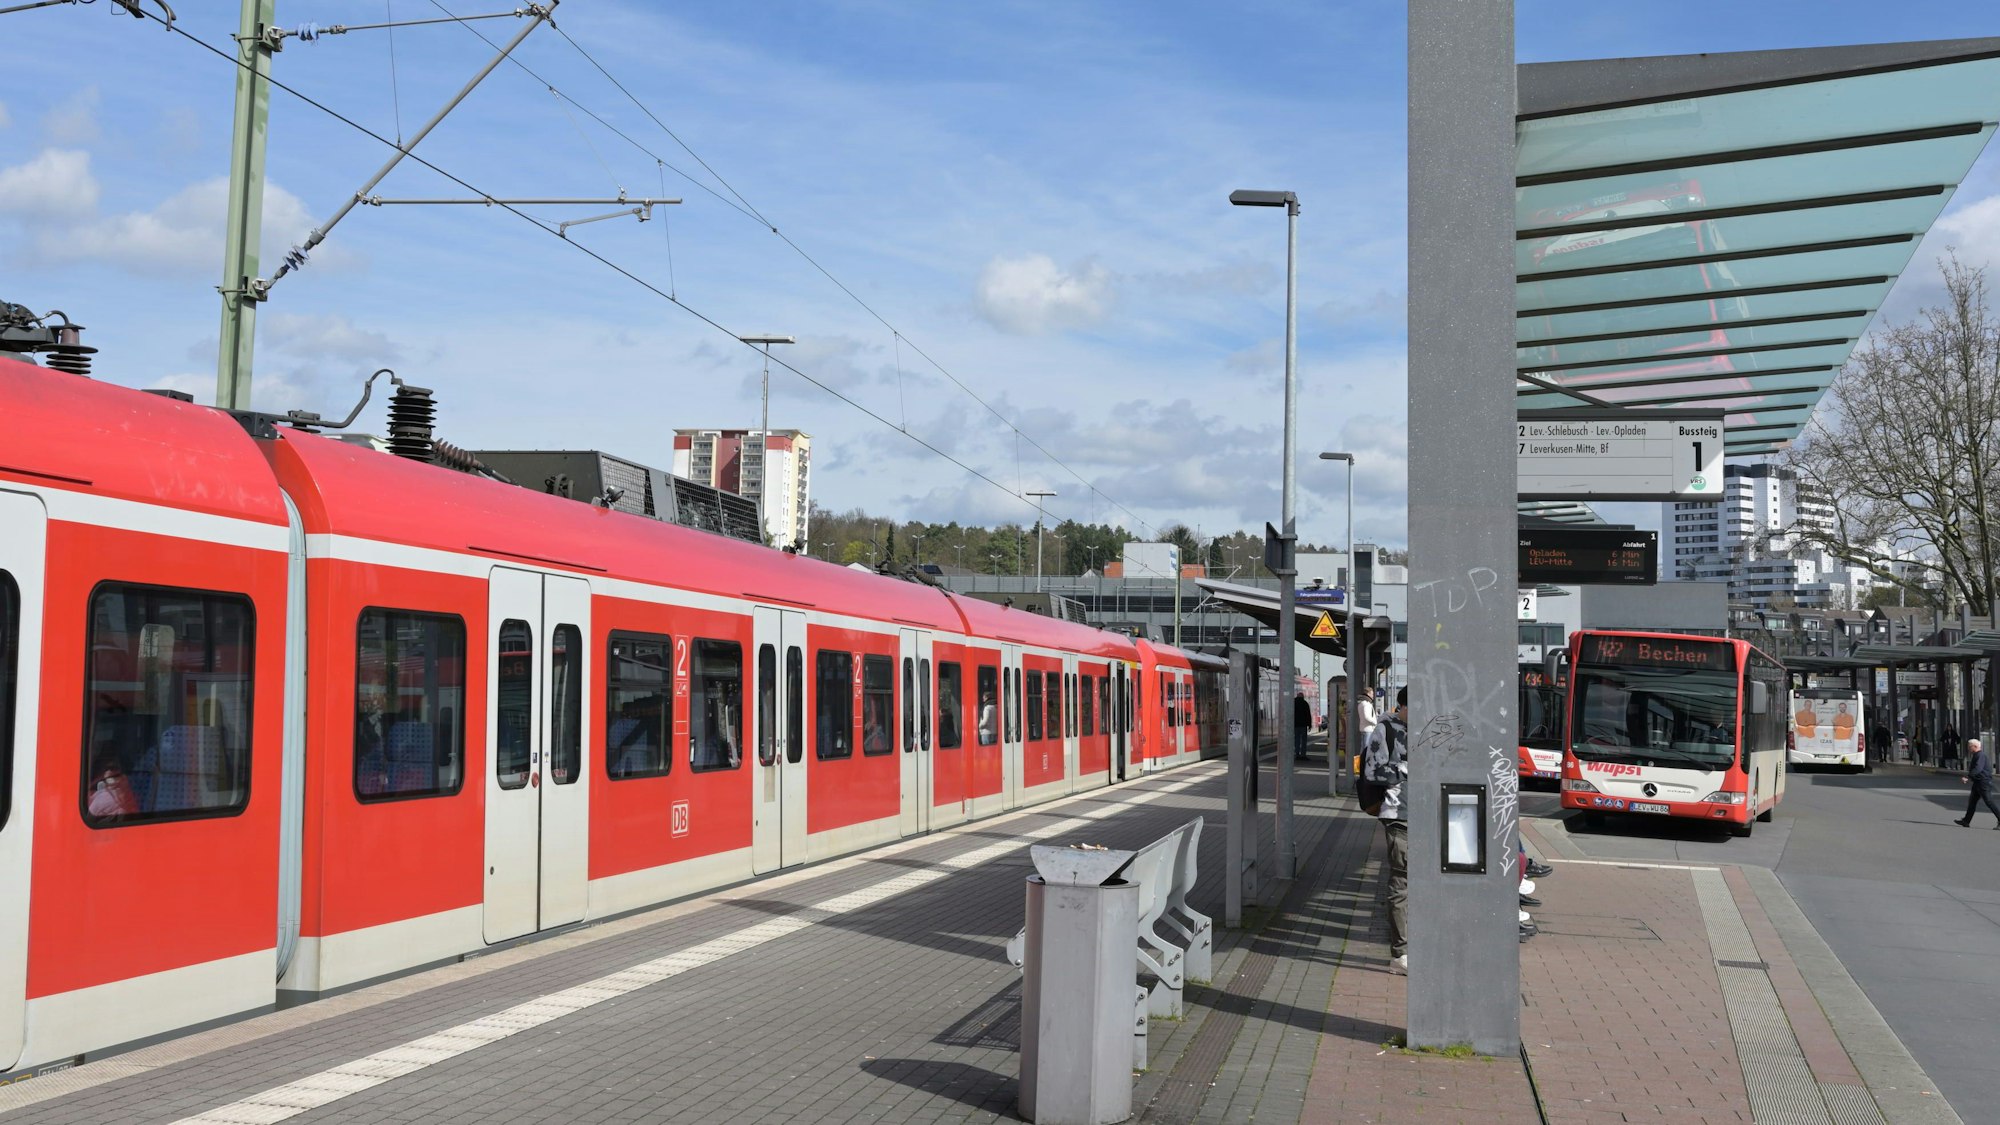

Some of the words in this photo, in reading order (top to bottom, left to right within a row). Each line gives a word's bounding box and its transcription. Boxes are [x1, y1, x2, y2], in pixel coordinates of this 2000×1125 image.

[1529, 425, 1589, 437] Lev.-Schlebusch
[1596, 425, 1646, 438] Lev.-Opladen
[1679, 426, 1718, 438] Bussteig
[1529, 443, 1598, 455] Leverkusen-Mitte,
[1600, 443, 1609, 454] Bf
[1692, 442, 1702, 471] 1
[1529, 549, 1566, 559] Opladen
[1622, 550, 1640, 558] Min
[1523, 597, 1530, 610] 2
[676, 639, 687, 676] 2
[1638, 643, 1708, 663] Bechen
[855, 654, 861, 683] 2
[1525, 673, 1543, 686] 434
[1534, 753, 1555, 761] wupsi
[1587, 761, 1642, 777] wupsi
[673, 806, 687, 832] DB
